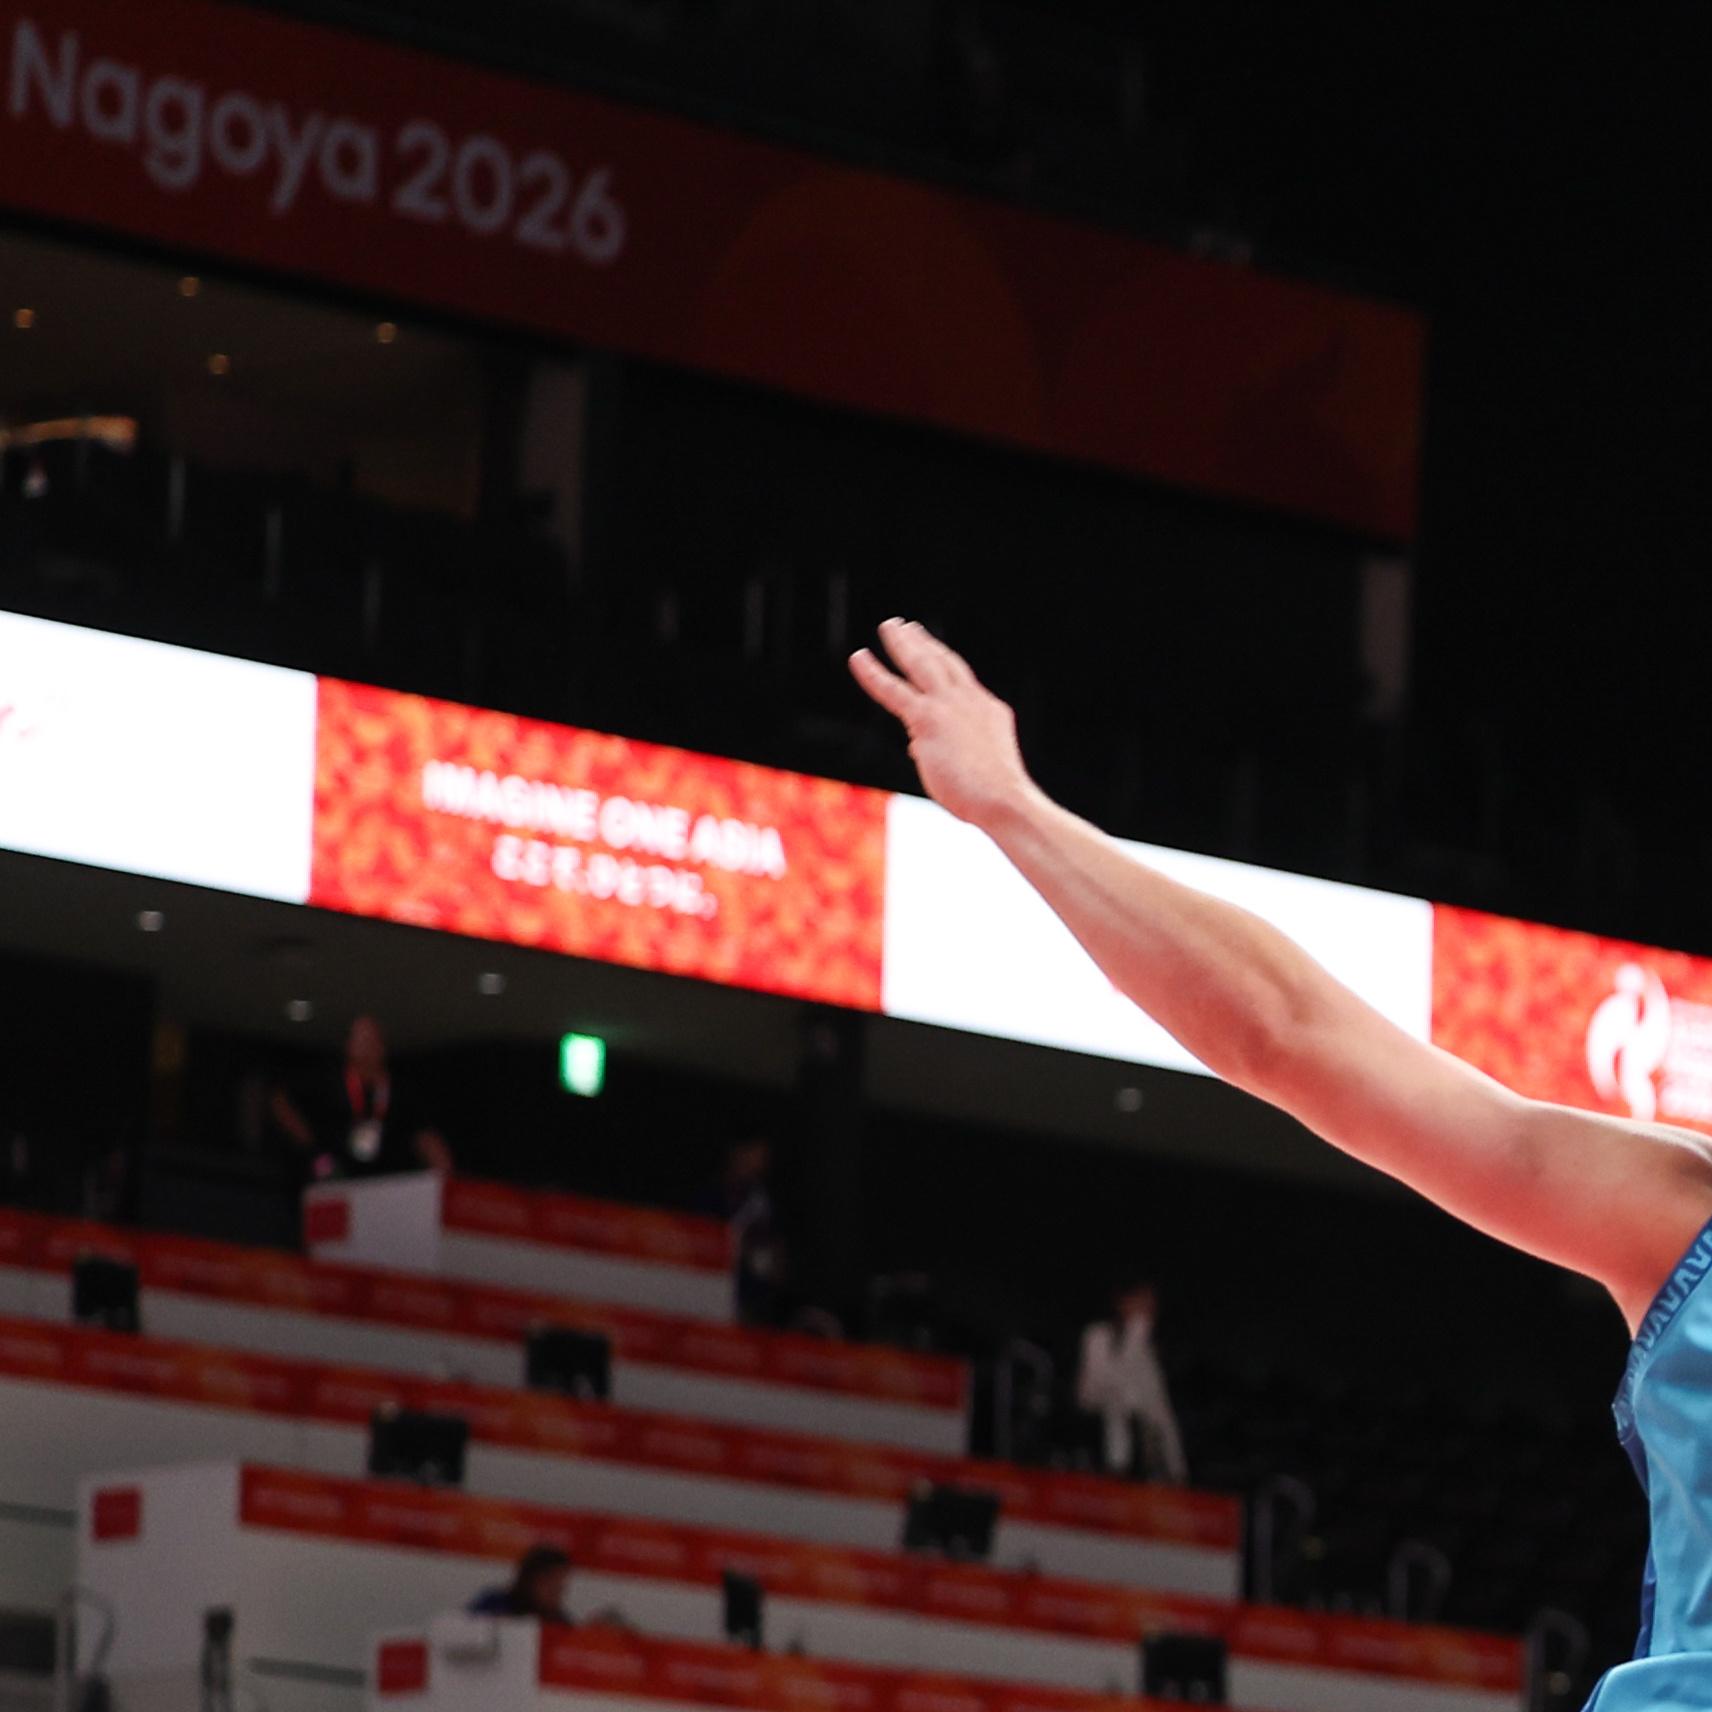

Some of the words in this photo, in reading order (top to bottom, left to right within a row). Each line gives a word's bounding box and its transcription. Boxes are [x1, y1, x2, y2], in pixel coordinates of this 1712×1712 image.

[10, 19, 379, 216] Nagoya
[393, 120, 629, 265] 2026
[421, 759, 600, 842] IMAGINE
[599, 794, 691, 861] ONE
[690, 814, 787, 881] ASIA
